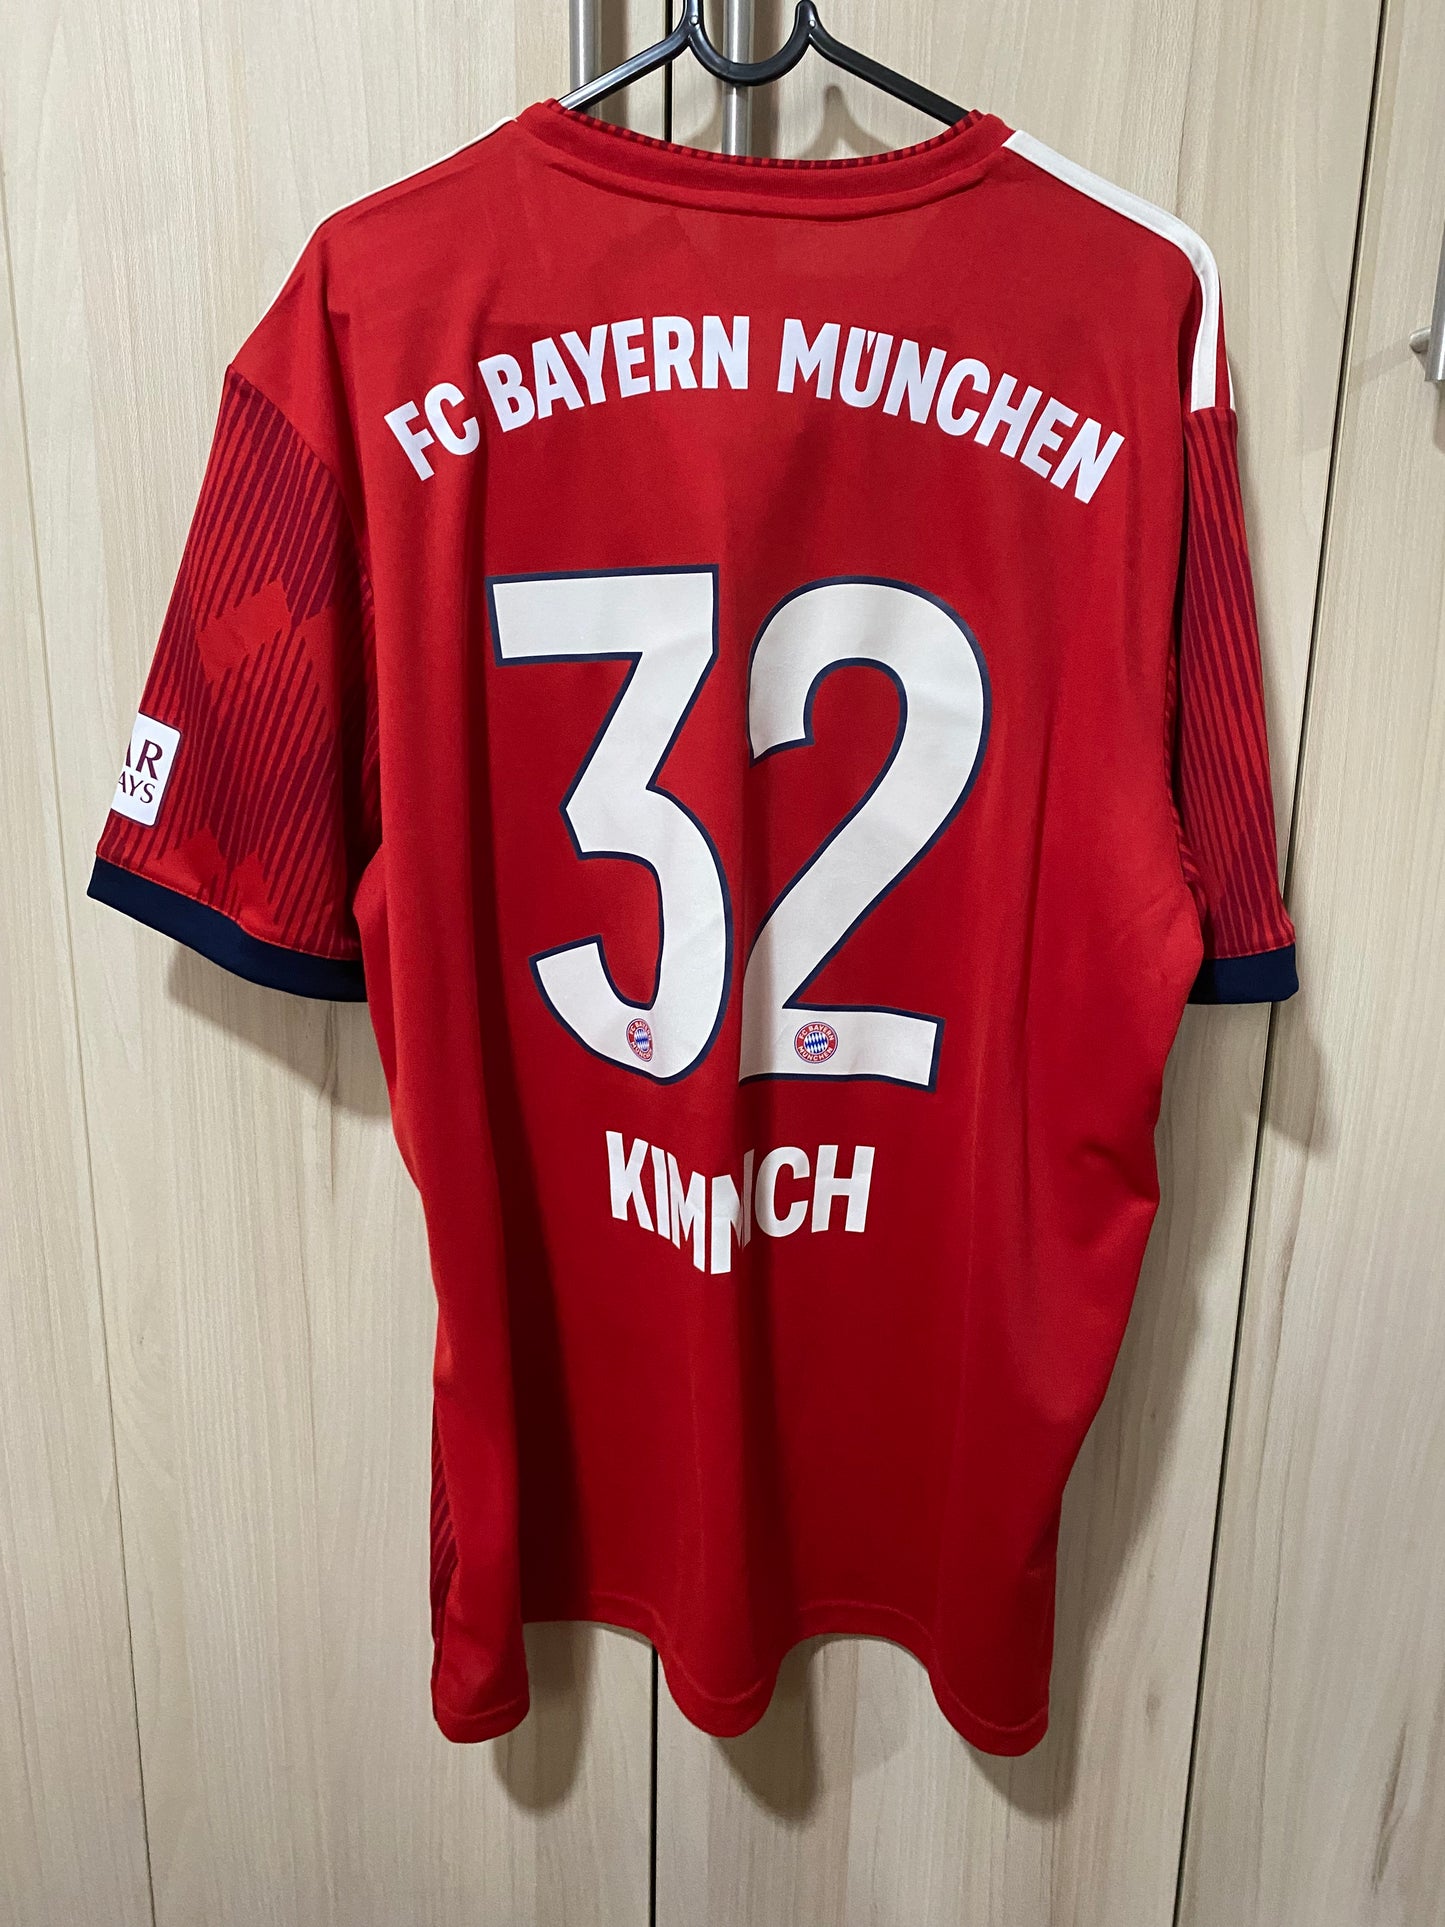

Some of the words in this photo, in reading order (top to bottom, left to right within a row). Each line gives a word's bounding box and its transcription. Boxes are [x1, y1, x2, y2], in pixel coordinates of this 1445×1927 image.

[384, 382, 480, 482] FC
[477, 315, 750, 433] BAYERN
[777, 318, 1126, 505] MÜNCHEN
[485, 564, 992, 1093] 32
[798, 1030, 808, 1040] FC
[808, 1024, 835, 1041] BAYERN
